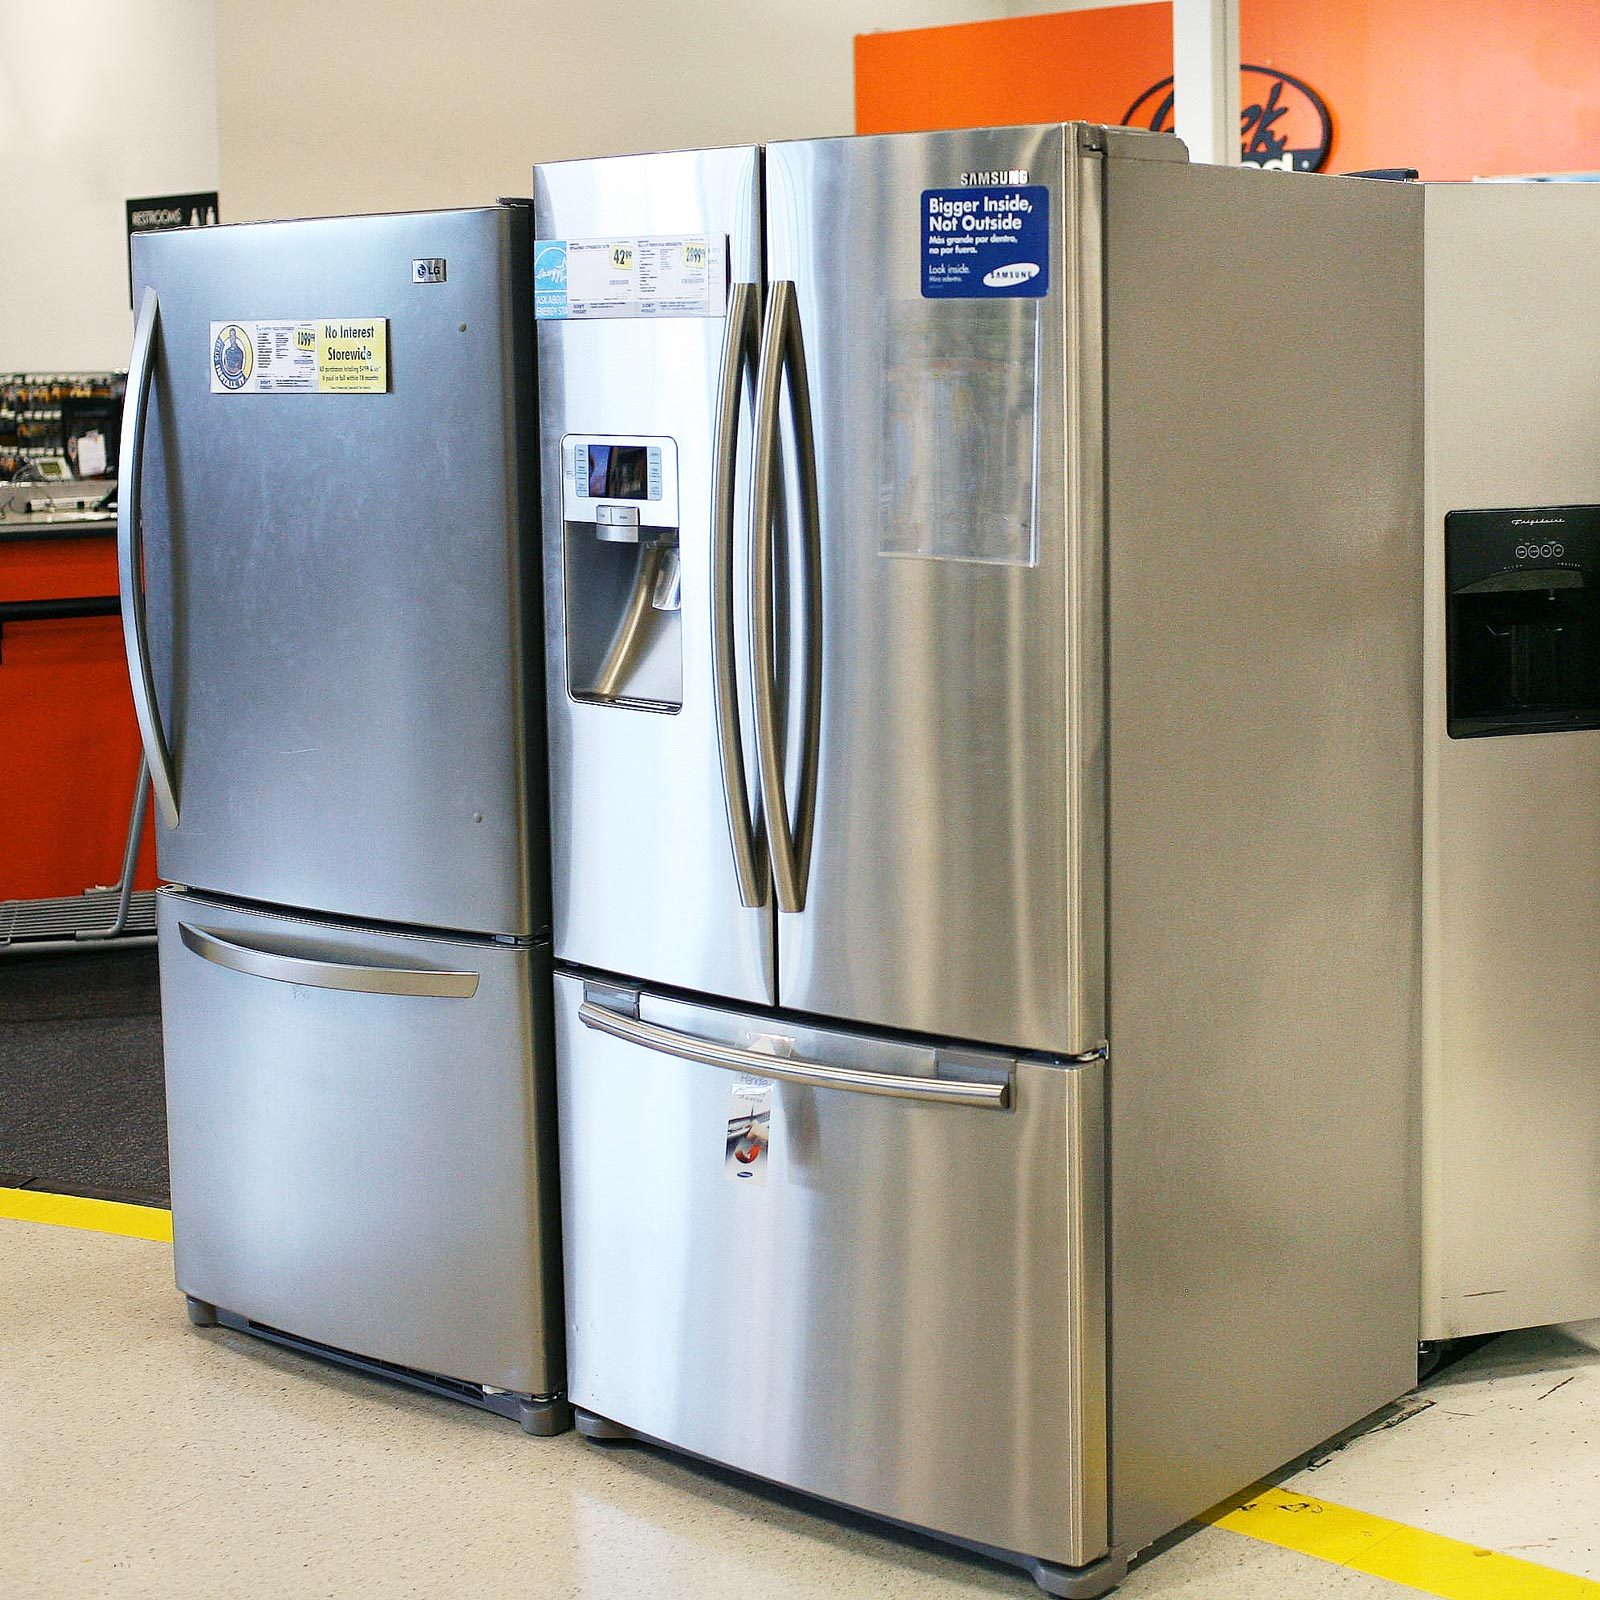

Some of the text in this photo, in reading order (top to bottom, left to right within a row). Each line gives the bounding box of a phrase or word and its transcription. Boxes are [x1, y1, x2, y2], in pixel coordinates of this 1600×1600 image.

[960, 170, 1028, 185] SAMSUNG
[929, 194, 1032, 217] Bigger Inside,
[132, 208, 181, 227] RESTROOMS
[929, 213, 1022, 231] Not Outside
[929, 234, 1018, 246] Más grande por dentro,
[940, 248, 954, 256] por
[955, 245, 978, 254] fuera.
[428, 266, 440, 275] LG
[929, 264, 946, 274] Look
[990, 271, 1033, 279] SAMSUNG
[325, 325, 374, 338] No Interest
[328, 346, 372, 360] Storewide
